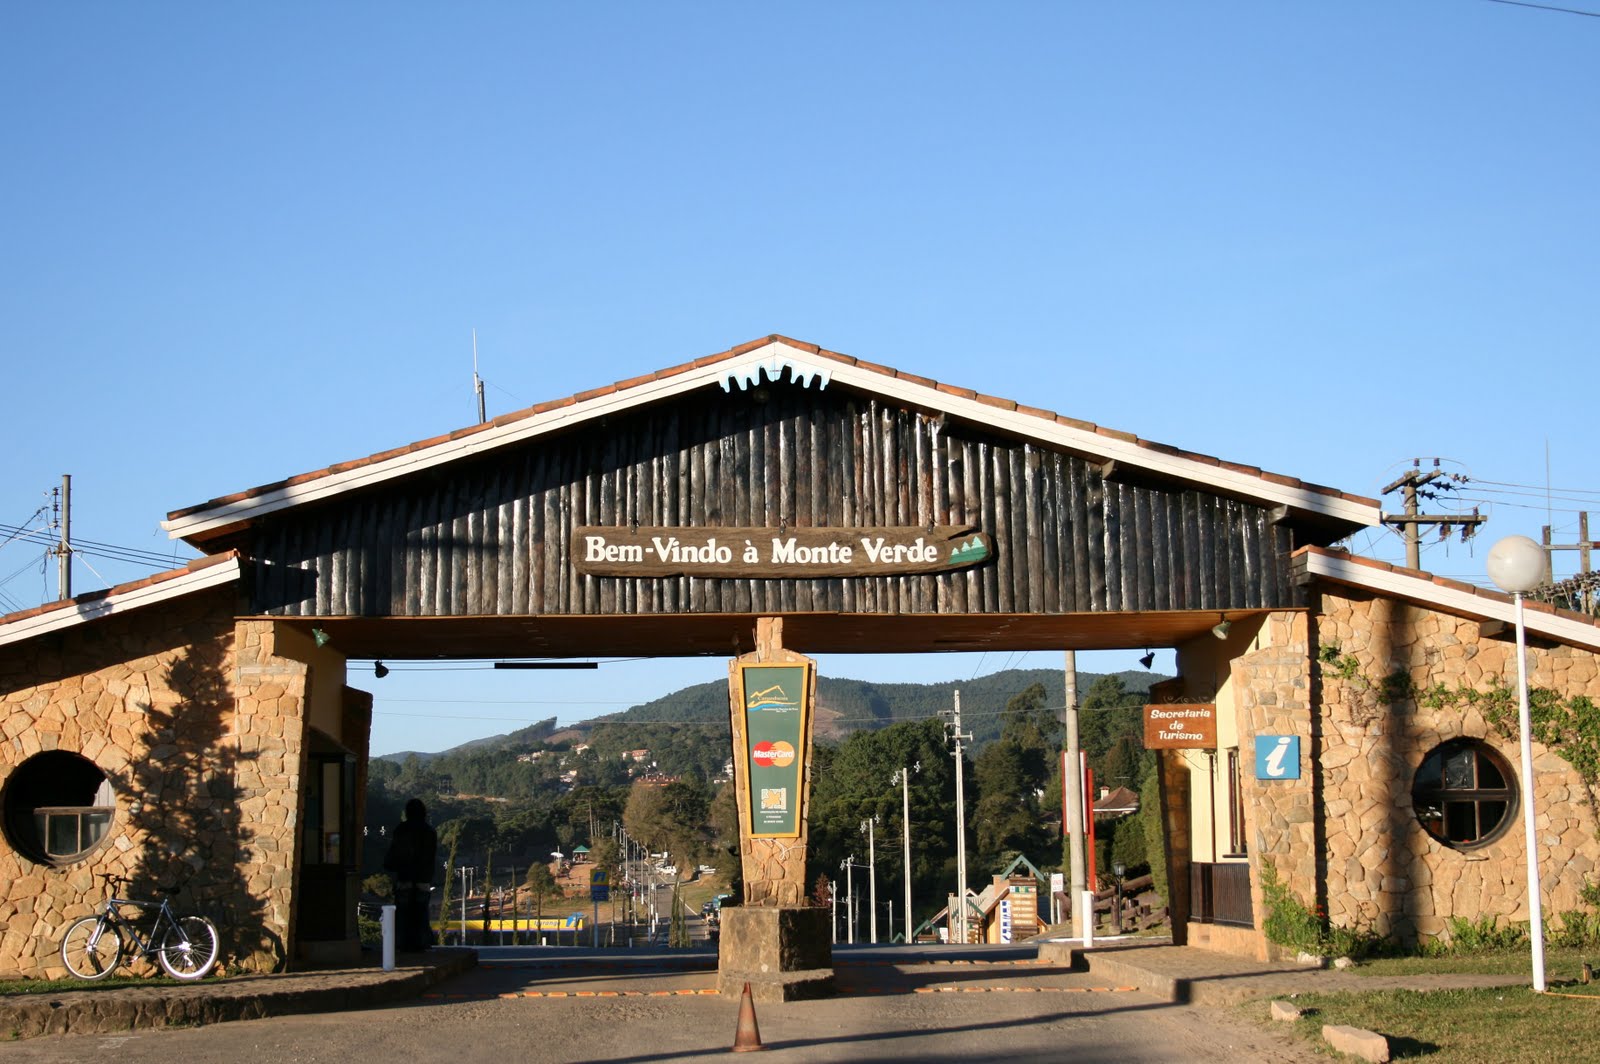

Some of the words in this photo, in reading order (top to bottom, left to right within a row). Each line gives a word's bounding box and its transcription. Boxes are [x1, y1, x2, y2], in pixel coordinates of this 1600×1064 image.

[585, 536, 732, 563] Bem-Vindo
[743, 540, 759, 563] à
[771, 538, 852, 564] Monte
[861, 538, 937, 563] Verde
[1150, 709, 1211, 719] Secretaria
[1169, 720, 1184, 730] de
[1158, 730, 1203, 741] Turismo
[753, 750, 794, 759] MasterCard
[1265, 736, 1291, 777] i
